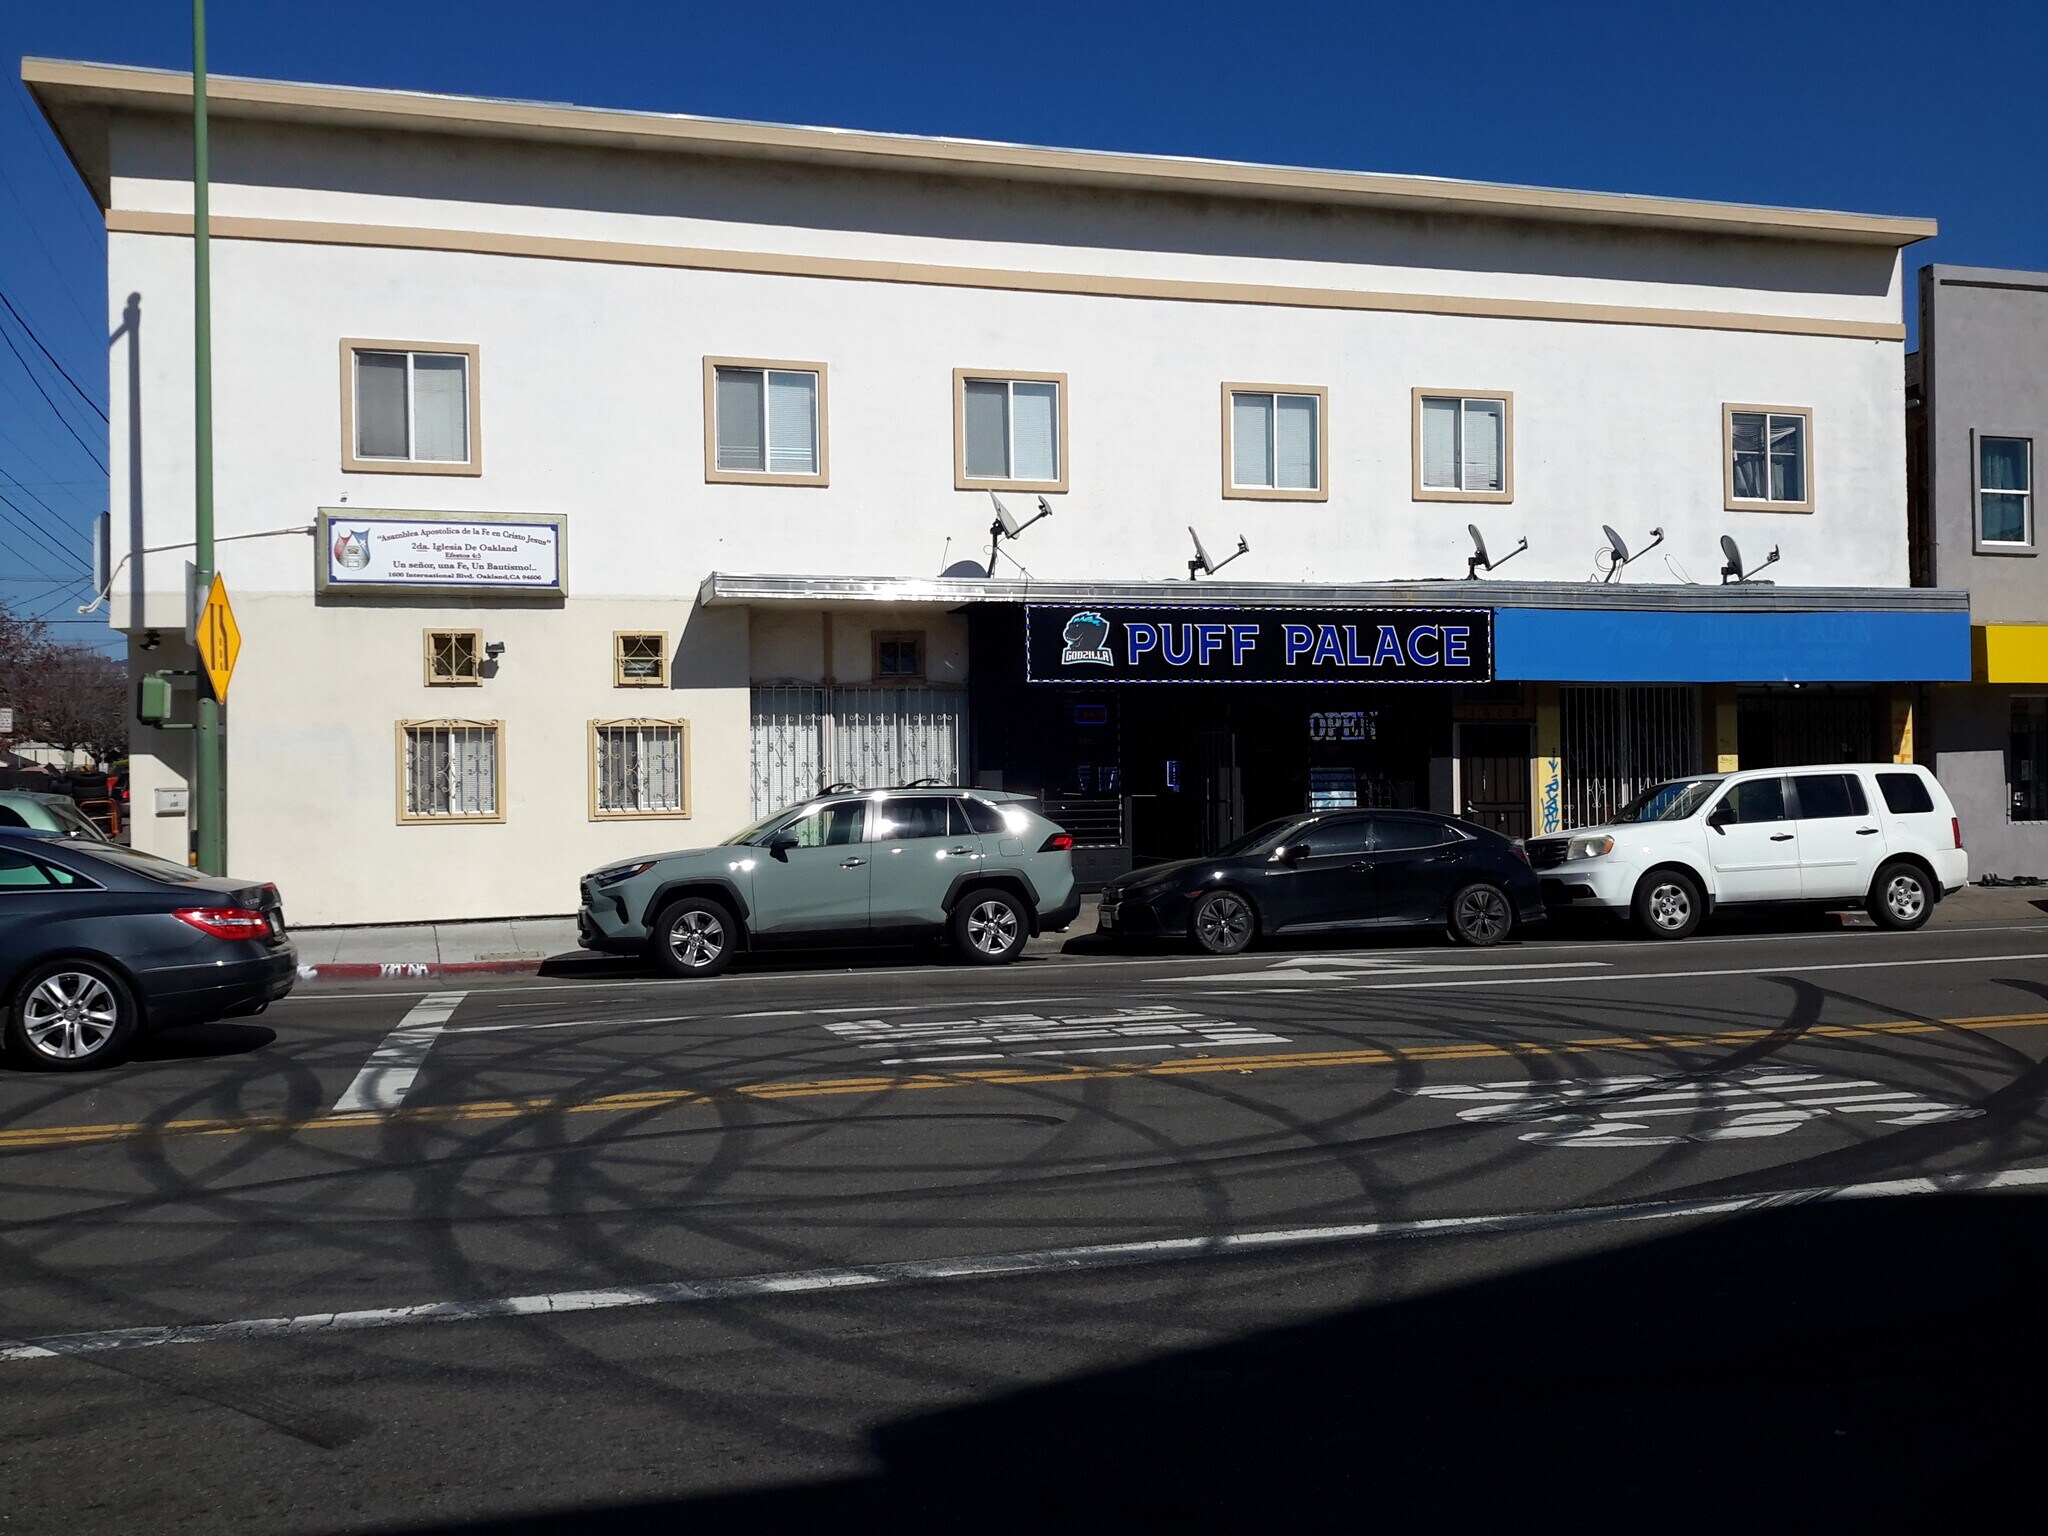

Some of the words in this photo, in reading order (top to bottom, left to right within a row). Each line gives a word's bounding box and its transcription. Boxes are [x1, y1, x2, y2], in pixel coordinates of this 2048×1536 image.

[420, 527, 460, 538] Apostolica
[462, 527, 472, 535] de
[473, 527, 481, 535] la
[482, 528, 491, 536] Fe
[502, 530, 526, 541] Cristo
[411, 542, 430, 552] 2da.
[432, 543, 462, 552] Iglesia
[465, 543, 477, 551] De
[479, 544, 518, 552] Oakland
[393, 560, 406, 568] Un
[408, 561, 436, 570] señor,
[457, 562, 469, 570] Fe,
[471, 562, 485, 570] Un
[1122, 622, 1260, 666] PUFF
[1280, 623, 1471, 667] PALACE
[1065, 650, 1110, 662] GODZILLA
